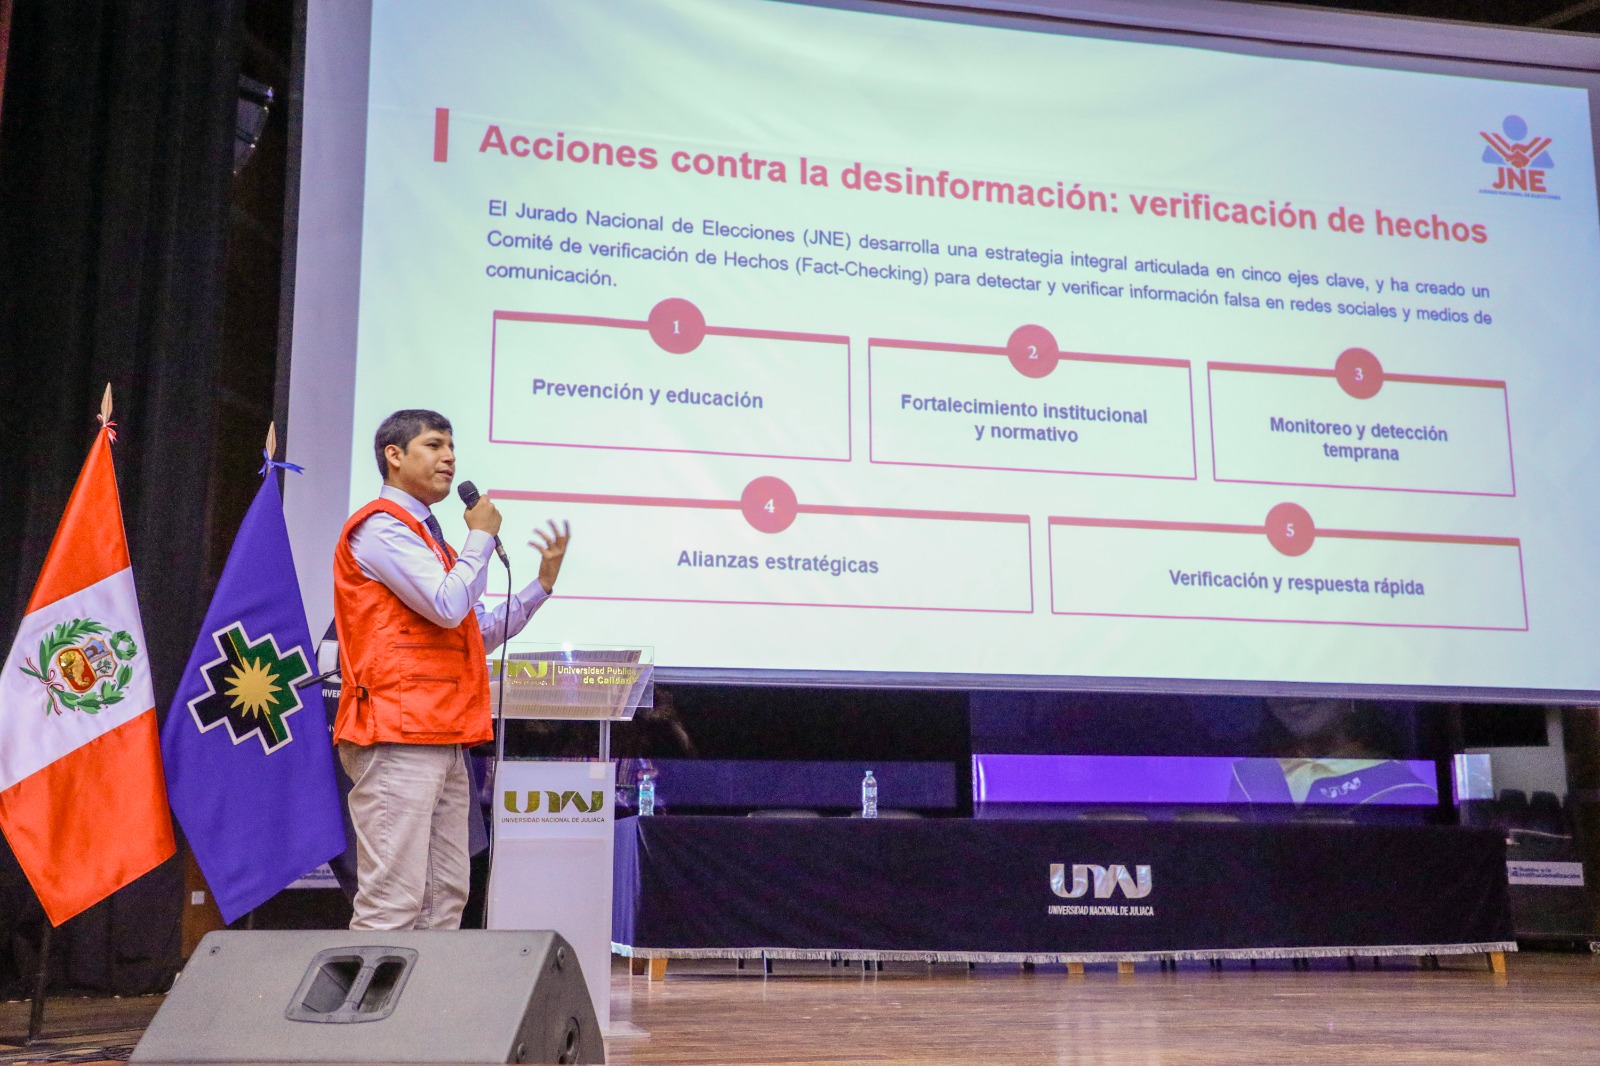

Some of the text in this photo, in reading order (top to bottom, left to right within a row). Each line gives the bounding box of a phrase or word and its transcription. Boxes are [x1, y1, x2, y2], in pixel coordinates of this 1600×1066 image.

[479, 125, 1488, 243] Acciones contra la desinformación: verificación de hechos
[1492, 166, 1547, 193] JNE
[489, 199, 1489, 298] El Jurado Nacional de Elecciones (JNE) desarrolla una estrategia integral articulada en cinco ejes clave, y ha creado un
[486, 265, 617, 286] comunicación.
[487, 230, 1492, 325] Comité de verificación de Hechos (Fact-Checking) para detectar y verificar información falsa en redes sociales y medios de
[673, 320, 680, 334] 1
[1027, 345, 1038, 359] 2
[1355, 367, 1364, 381] 3
[533, 378, 763, 408] Prevención y educación
[901, 394, 1147, 424] Fortalecimiento institucional
[974, 425, 1078, 443] y normativo
[1270, 416, 1448, 441] Monitoreo y detección
[1323, 443, 1399, 462] temprana
[763, 498, 775, 513] 4
[1286, 523, 1295, 537] 5
[677, 550, 879, 576] Alianzas estratégicas
[1169, 569, 1424, 598] Verificación y respuesta rápida
[583, 676, 631, 685] de Calidad
[1048, 905, 1154, 916] UNIVERSIDAD NACIONAL DE JULIACA
